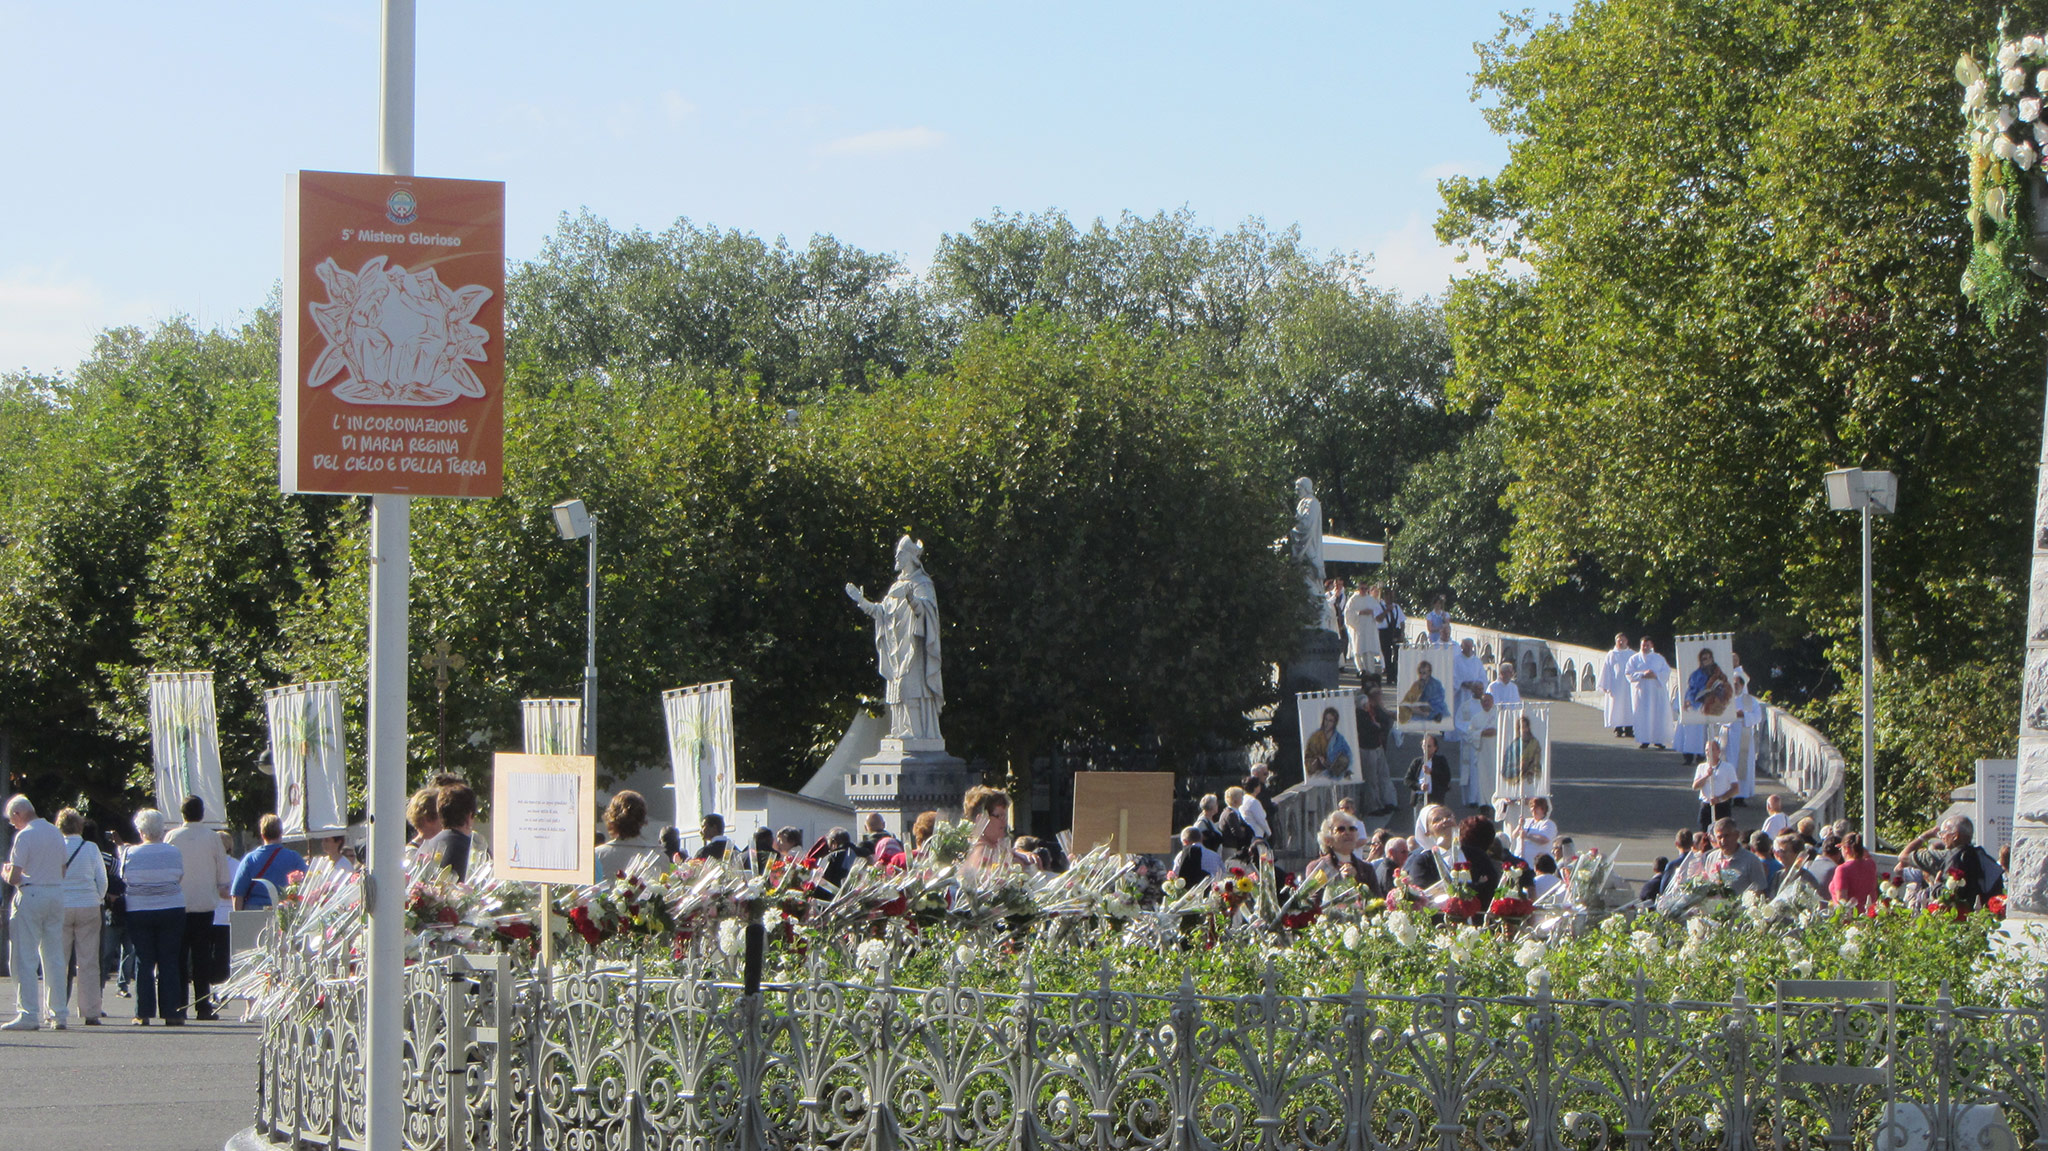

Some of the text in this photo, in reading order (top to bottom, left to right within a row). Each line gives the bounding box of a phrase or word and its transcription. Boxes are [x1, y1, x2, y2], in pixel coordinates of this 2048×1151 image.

[358, 229, 406, 244] Mistero
[409, 232, 461, 247] Glorioso
[332, 413, 468, 434] L'INCORONAZIONE
[342, 435, 460, 454] DI MARIA REGINA
[313, 454, 487, 476] DEL CIELO E DELLA TERRA
